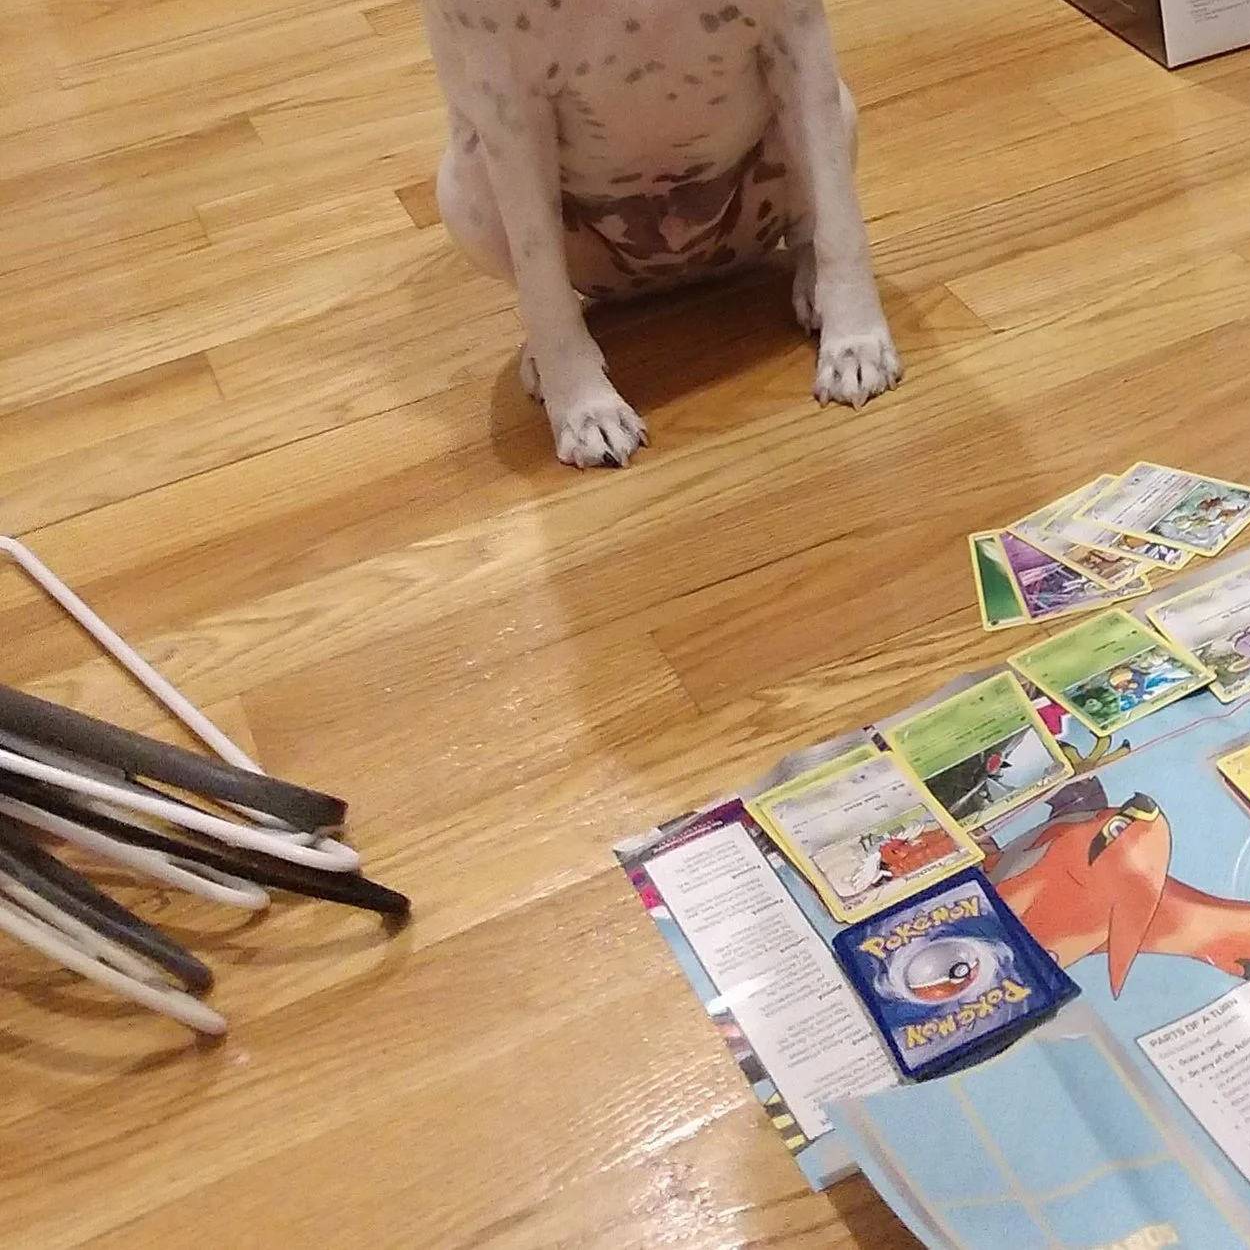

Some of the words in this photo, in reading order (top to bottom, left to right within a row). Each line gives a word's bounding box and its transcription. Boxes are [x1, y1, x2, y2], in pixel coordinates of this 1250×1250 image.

[1148, 1026, 1186, 1047] PARTS
[1184, 1020, 1200, 1033] OF
[1200, 1014, 1210, 1023] A
[1210, 997, 1238, 1018] TURN
